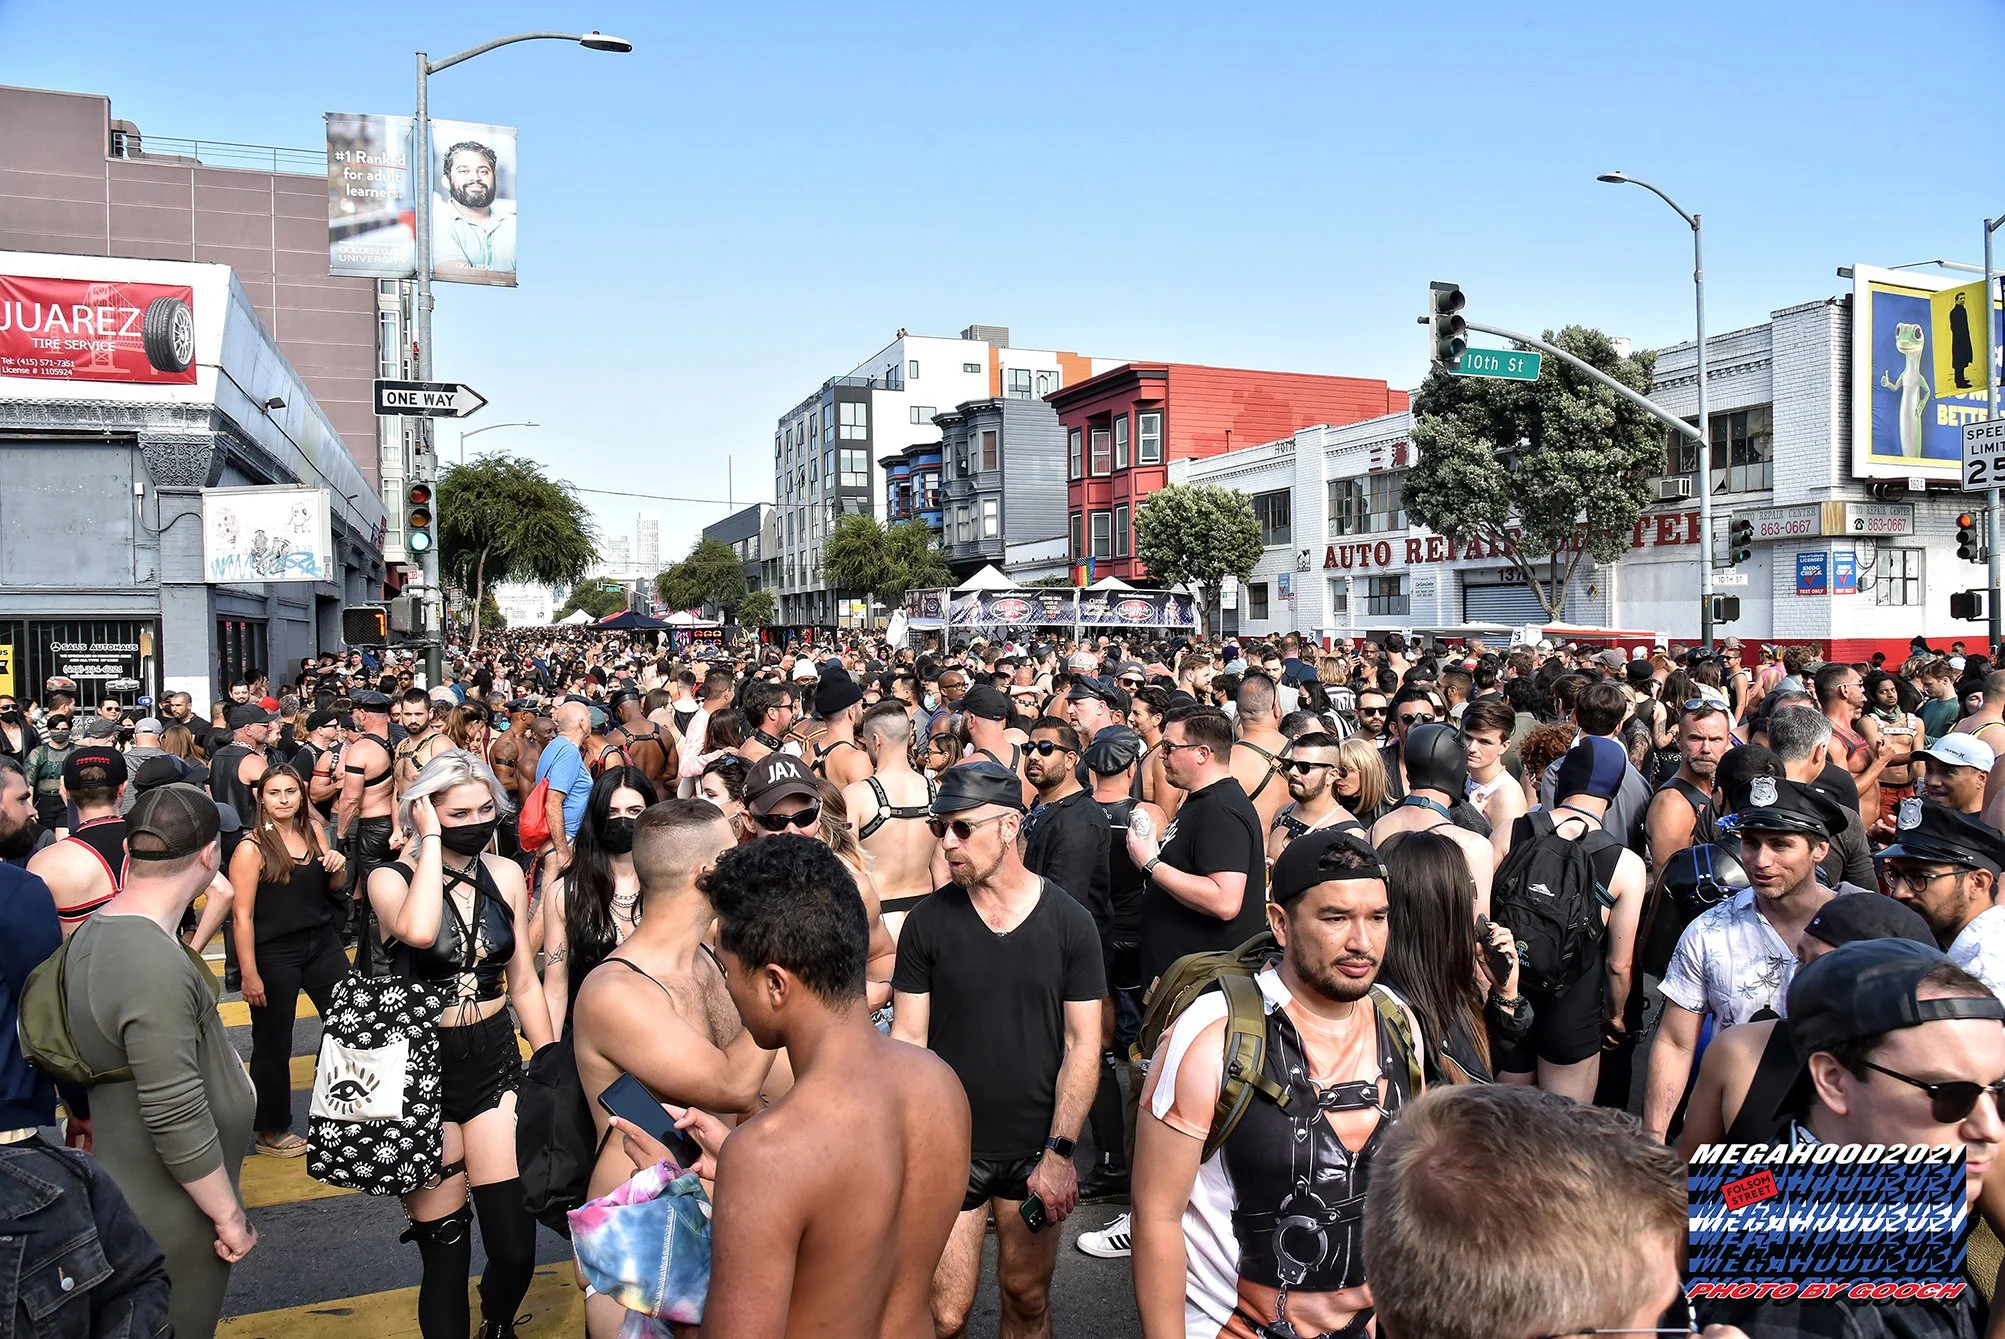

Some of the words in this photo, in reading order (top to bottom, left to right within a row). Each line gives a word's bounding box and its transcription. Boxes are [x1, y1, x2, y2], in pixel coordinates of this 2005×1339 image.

[334, 150, 351, 163] #1
[356, 150, 406, 166] Ranked
[343, 167, 363, 180] for
[366, 169, 401, 182] adult
[346, 182, 403, 199] learners.
[338, 246, 380, 255] GOLDEN
[338, 254, 409, 264] UNIVERSITY
[0, 300, 141, 337] JUAREZ
[32, 338, 60, 350] TIRE
[64, 339, 116, 352] SERVICE
[1, 357, 15, 365] Tel:
[17, 358, 38, 367] (415)
[1467, 354, 1499, 371] 10th
[1508, 358, 1524, 372] St
[2, 366, 30, 375] License
[41, 368, 73, 376] 1105924
[387, 391, 418, 405] ONE
[423, 393, 455, 407] WAY
[1937, 404, 1999, 426] BETTE
[1967, 425, 2005, 440] SPEE
[1910, 479, 1924, 490] 1924
[1758, 510, 1784, 521] REPAIR
[1788, 507, 1817, 519] CENTER
[1848, 505, 1863, 515] AUTO
[1866, 505, 1887, 515] REPAIR
[1889, 506, 1911, 516] CENTER
[1761, 519, 1812, 537] 863-0667
[1867, 518, 1907, 532] 863-0667
[1323, 541, 1391, 569] AUTO
[1497, 568, 1536, 582] 137
[61, 643, 87, 652] SAL'S
[89, 643, 139, 652] AUTOHAUS
[768, 760, 801, 784] JAX
